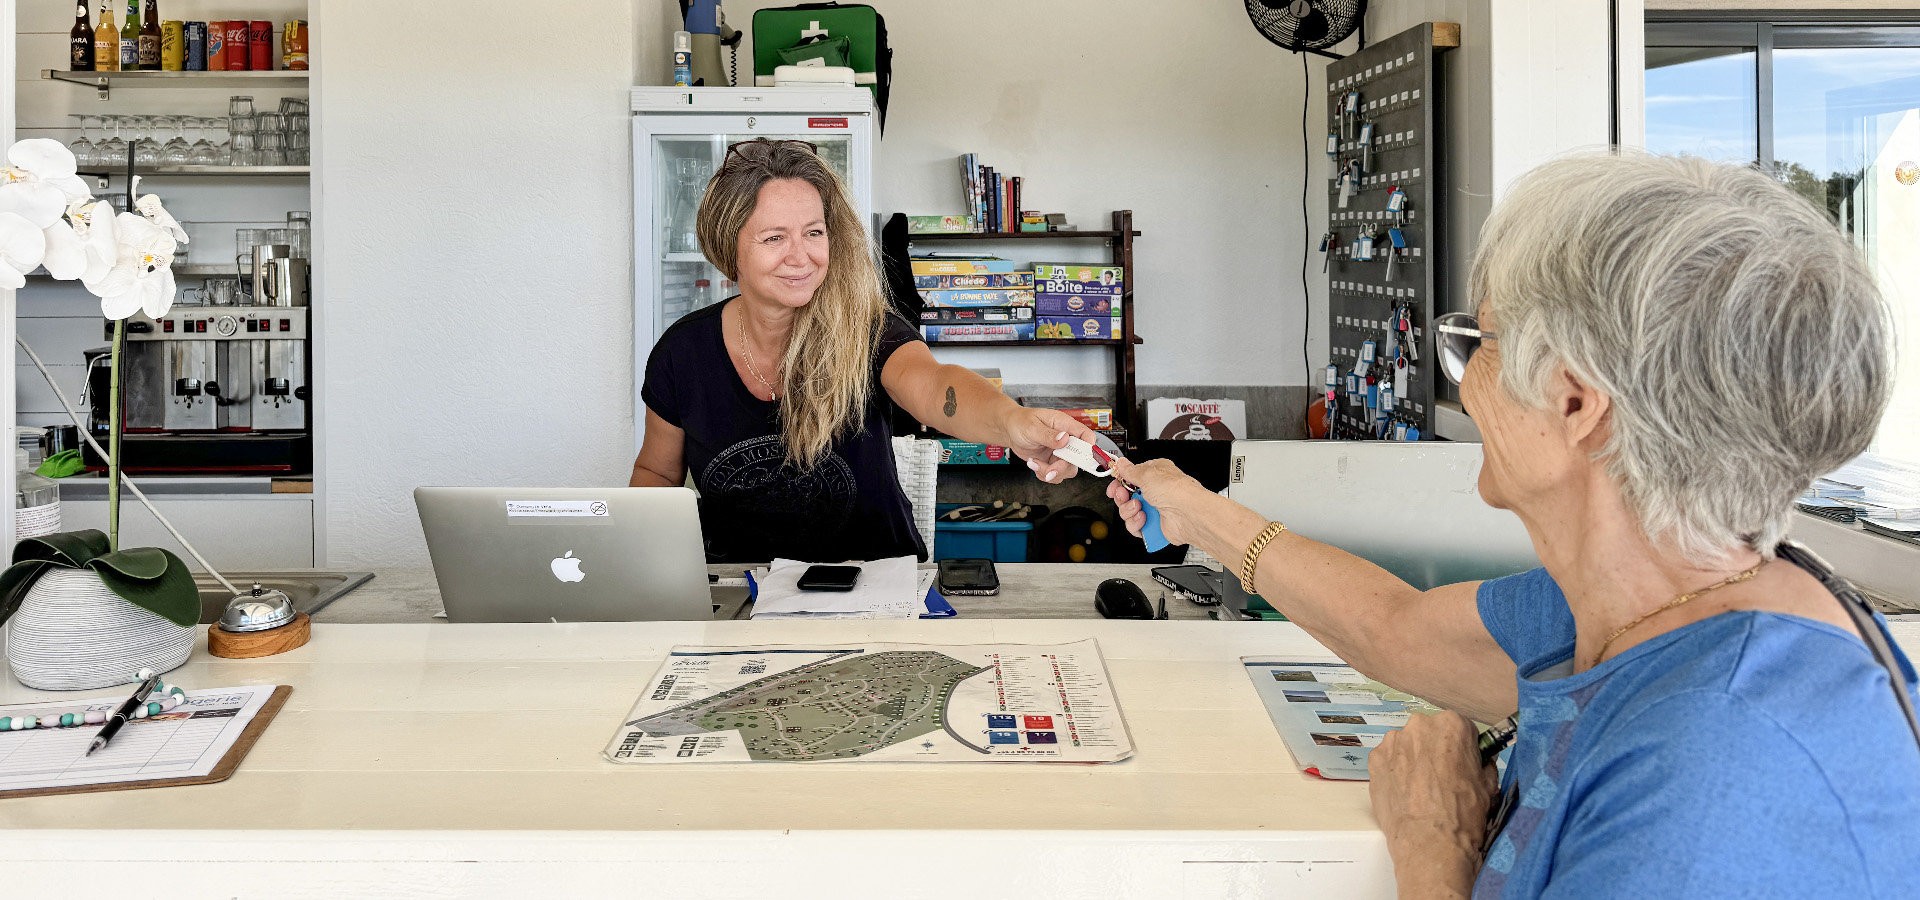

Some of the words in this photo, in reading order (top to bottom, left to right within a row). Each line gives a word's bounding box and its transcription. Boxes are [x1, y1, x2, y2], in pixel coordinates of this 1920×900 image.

[955, 277, 985, 286] Cluedo
[1046, 280, 1083, 293] Boîte
[951, 293, 959, 301] LA
[960, 292, 982, 300] BONNE
[983, 292, 999, 300] PAYE
[1174, 402, 1220, 414] TOSCAFFÈ
[1233, 457, 1242, 481] Lenovo
